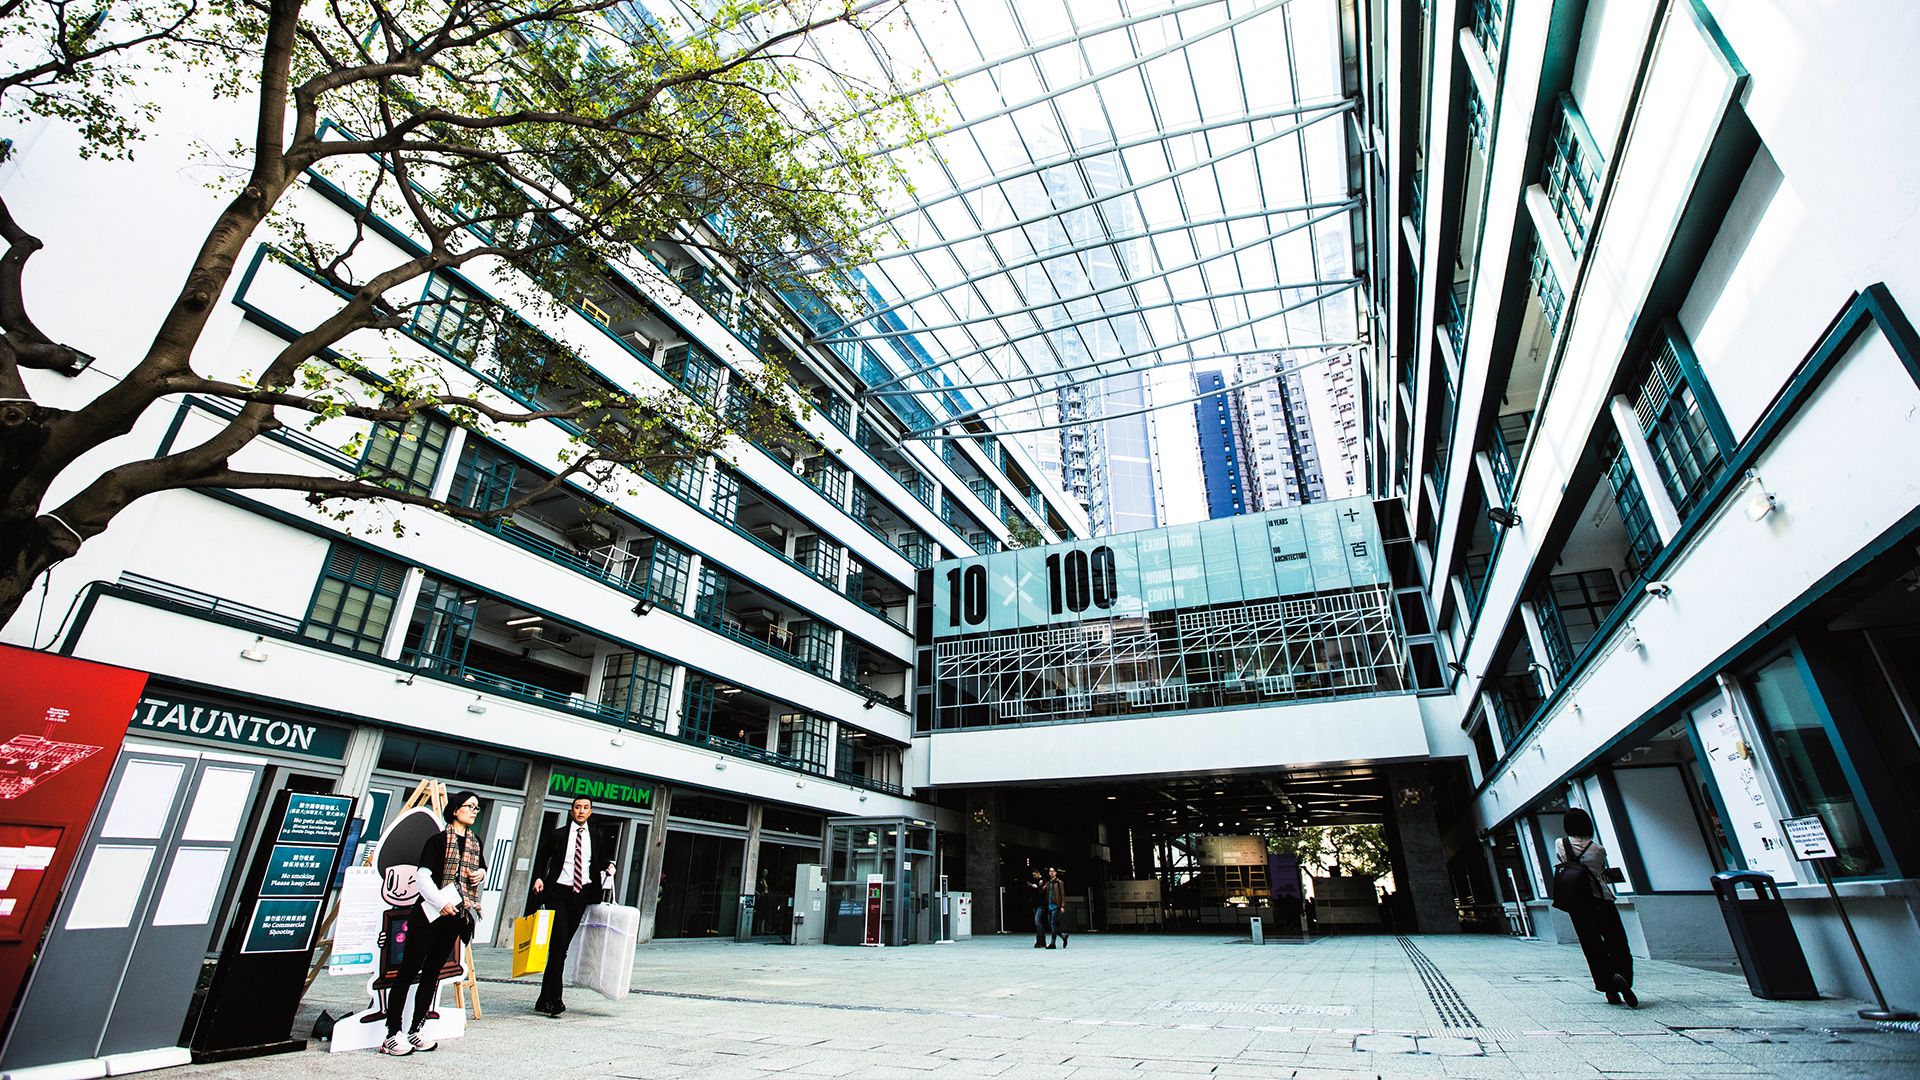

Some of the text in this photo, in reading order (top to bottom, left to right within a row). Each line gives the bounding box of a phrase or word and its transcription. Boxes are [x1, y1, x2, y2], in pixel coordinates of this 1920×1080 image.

[1273, 518, 1289, 526] YEARS
[1273, 546, 1281, 554] 100
[1274, 552, 1308, 563] ARCHITECTURE
[946, 564, 987, 628] 10
[1046, 545, 1118, 615] 100
[1147, 585, 1185, 603] EDITION
[315, 818, 337, 826] allowed
[291, 873, 316, 881] smoking
[290, 880, 305, 888] keep
[268, 929, 295, 937] Shooting
